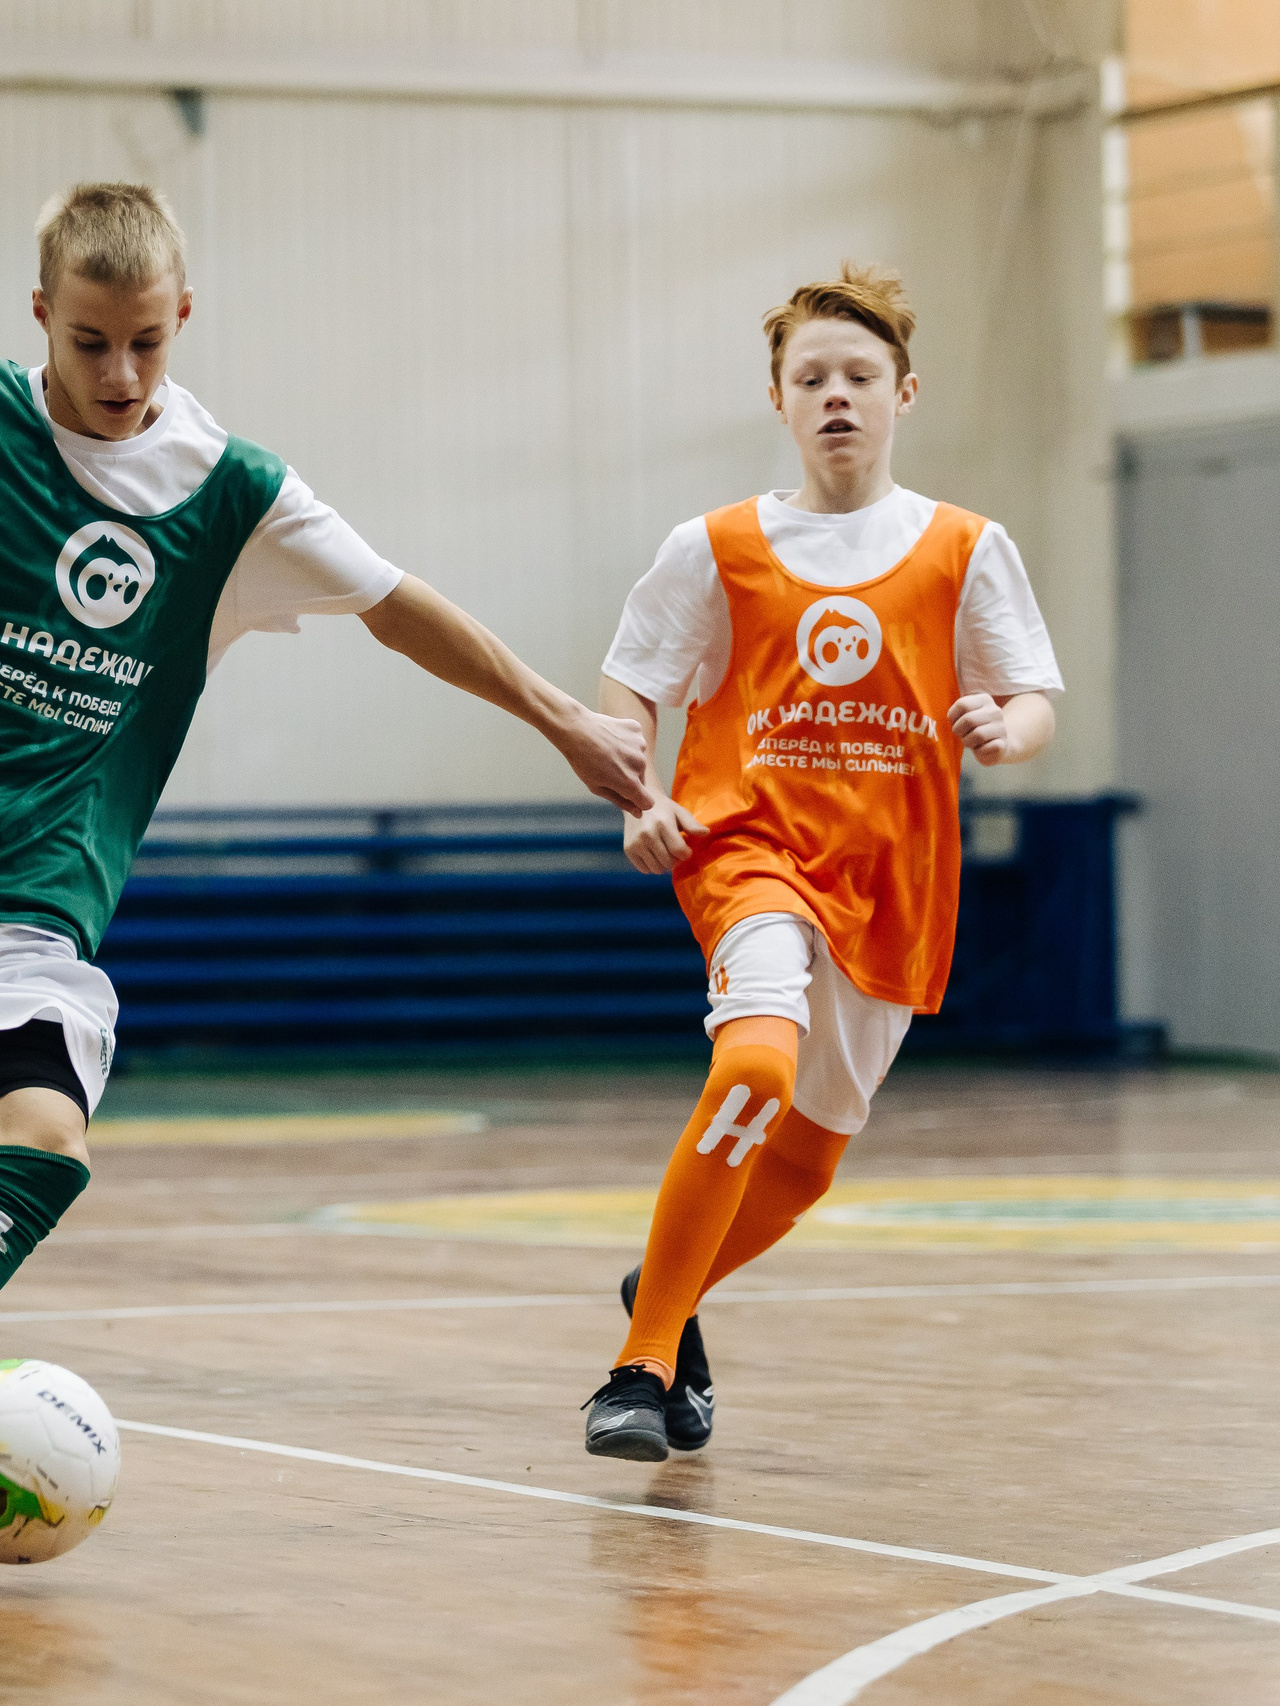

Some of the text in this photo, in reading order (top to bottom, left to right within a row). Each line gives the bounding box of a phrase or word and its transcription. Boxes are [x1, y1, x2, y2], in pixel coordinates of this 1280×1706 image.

[0, 621, 155, 687] НАДЕЖДИ
[27, 697, 62, 721] МЫ
[52, 685, 67, 702] К
[68, 690, 122, 717] ПОБЕЕ!
[825, 741, 837, 753] К
[812, 757, 841, 771] МЫ
